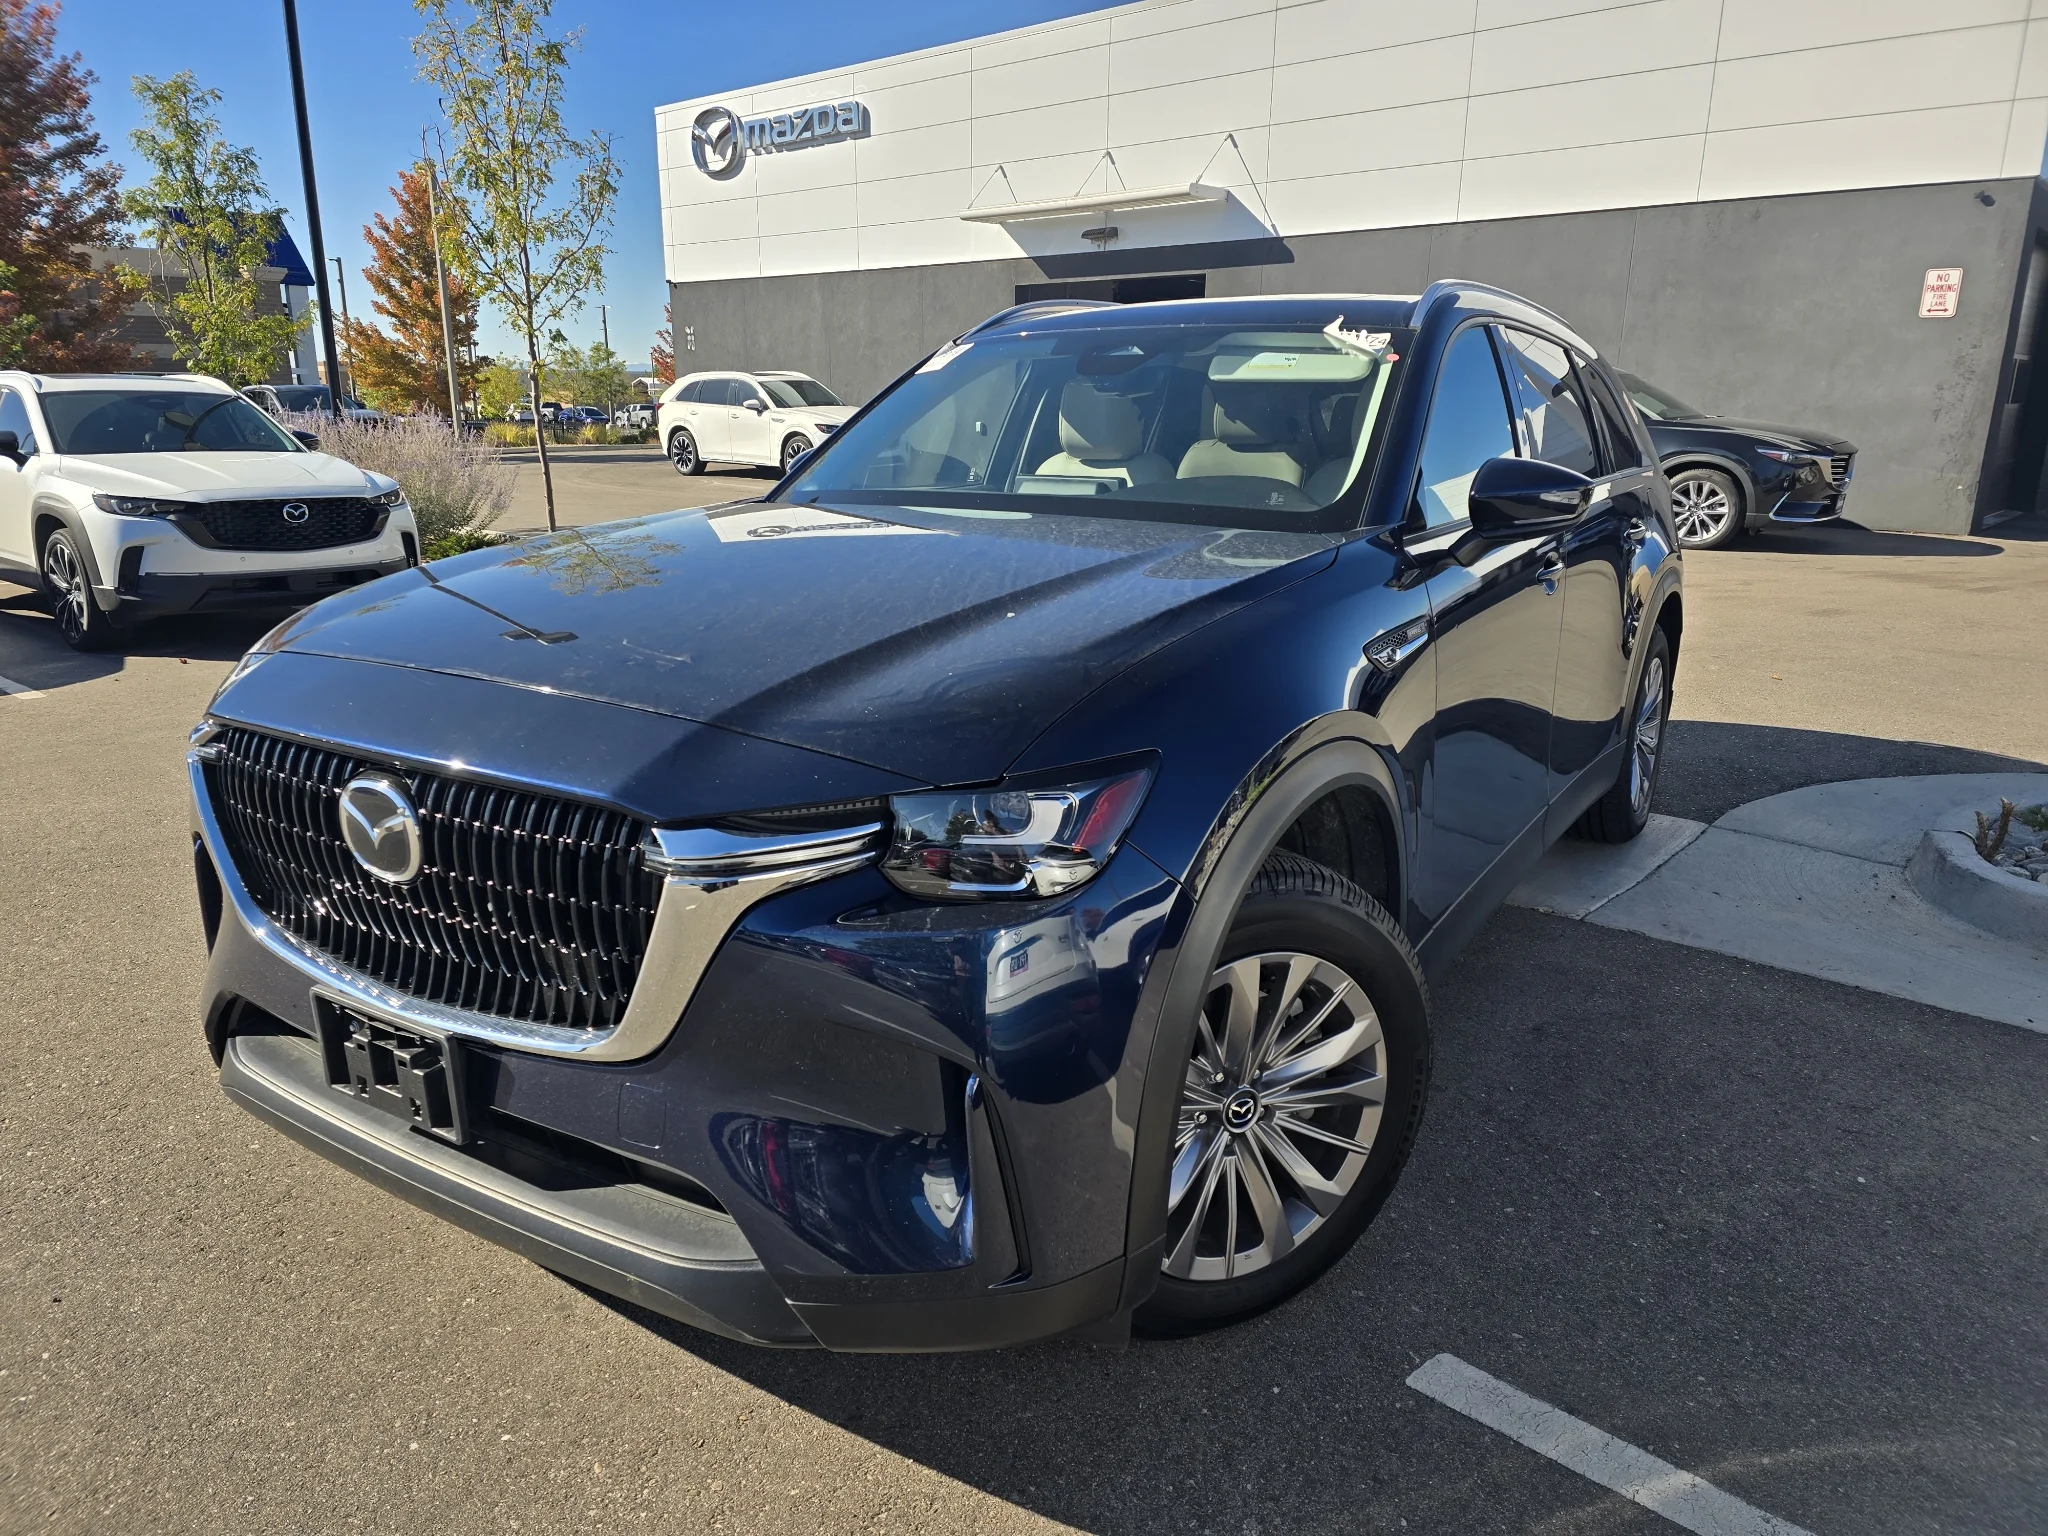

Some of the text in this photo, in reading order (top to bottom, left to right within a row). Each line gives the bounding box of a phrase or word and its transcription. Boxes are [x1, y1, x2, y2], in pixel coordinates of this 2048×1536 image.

[1936, 273, 1950, 283] NO
[1926, 284, 1957, 293] PARKING
[1388, 1058, 1424, 1174] MICHELIN
